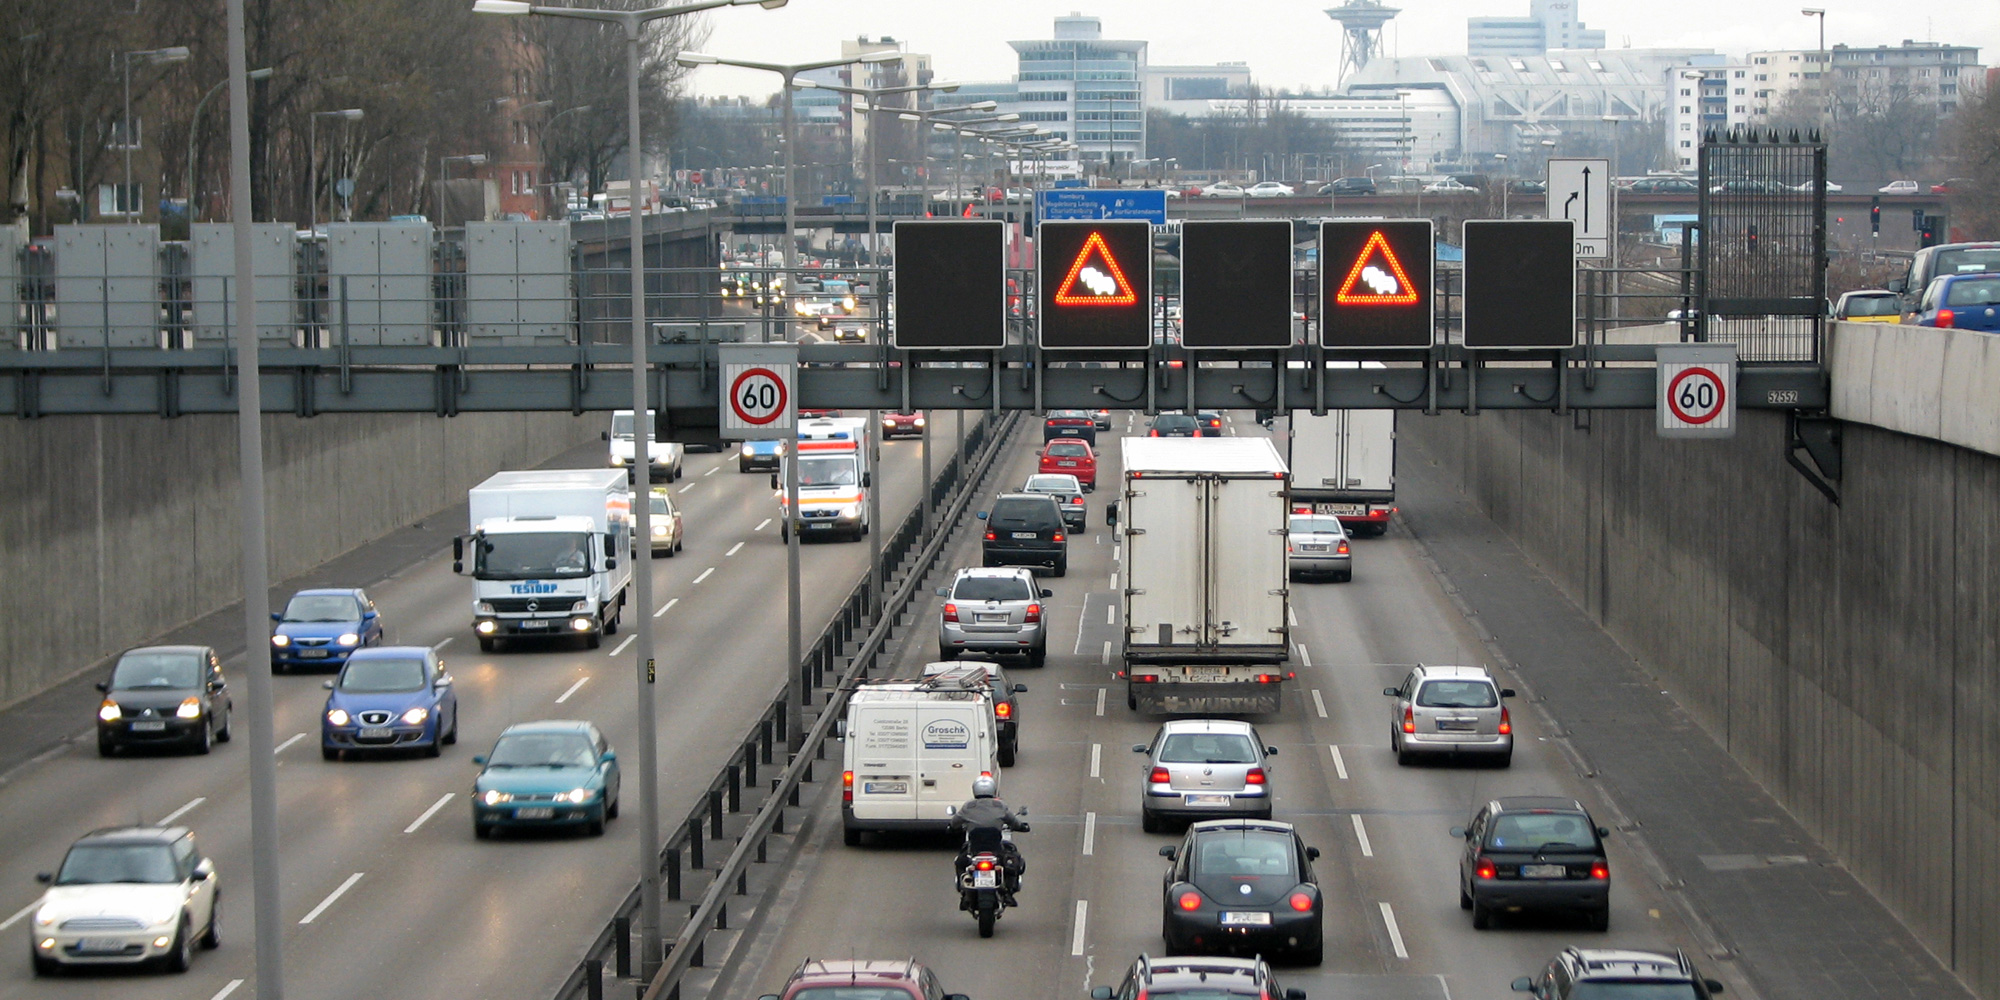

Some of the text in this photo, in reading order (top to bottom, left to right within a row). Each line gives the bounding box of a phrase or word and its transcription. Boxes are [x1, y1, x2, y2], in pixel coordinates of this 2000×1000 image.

[743, 383, 775, 409] 60
[1680, 383, 1713, 408] 60
[1769, 391, 1797, 402] 52552
